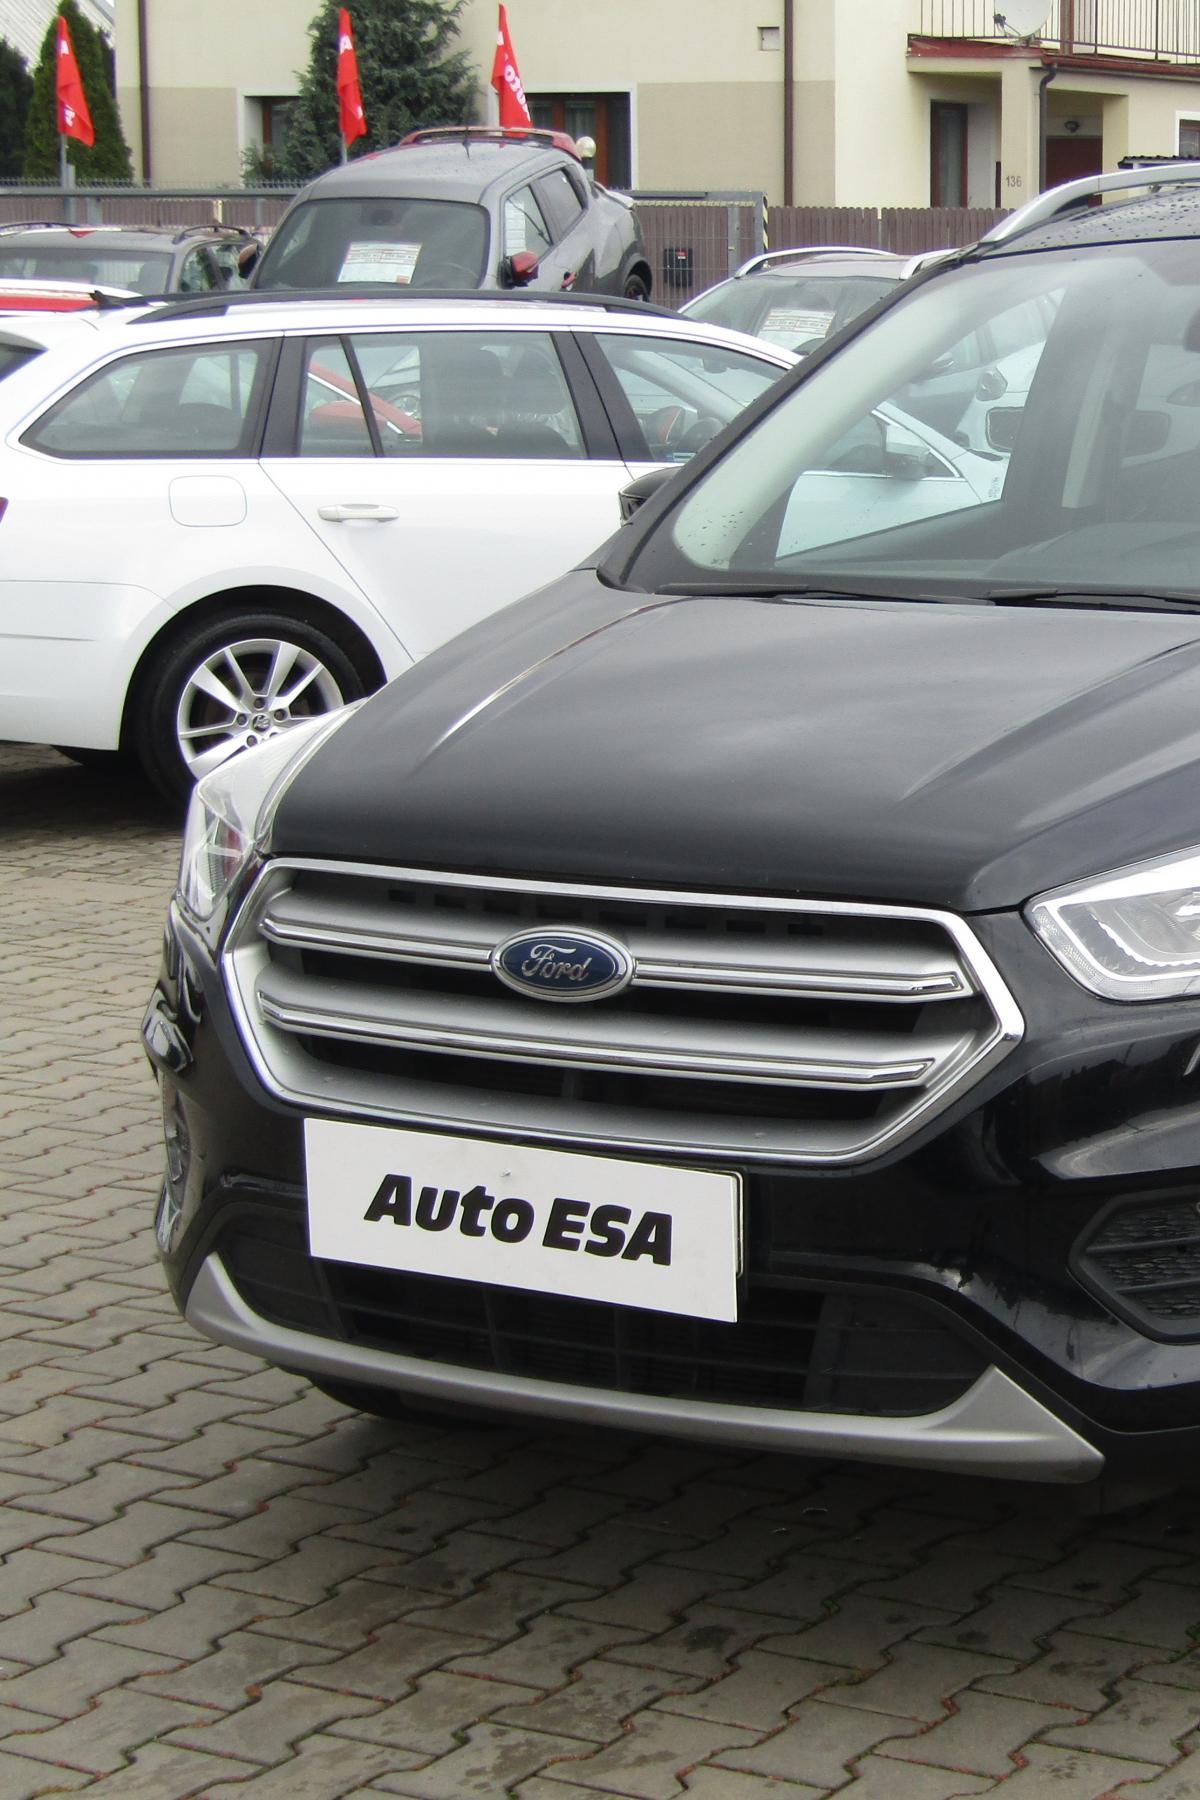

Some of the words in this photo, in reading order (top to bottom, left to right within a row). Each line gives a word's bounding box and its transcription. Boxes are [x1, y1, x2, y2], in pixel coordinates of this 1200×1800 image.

[1006, 175, 1022, 188] 136
[521, 943, 593, 982] Ford
[363, 1173, 535, 1244] Auto
[542, 1197, 673, 1267] ESA
